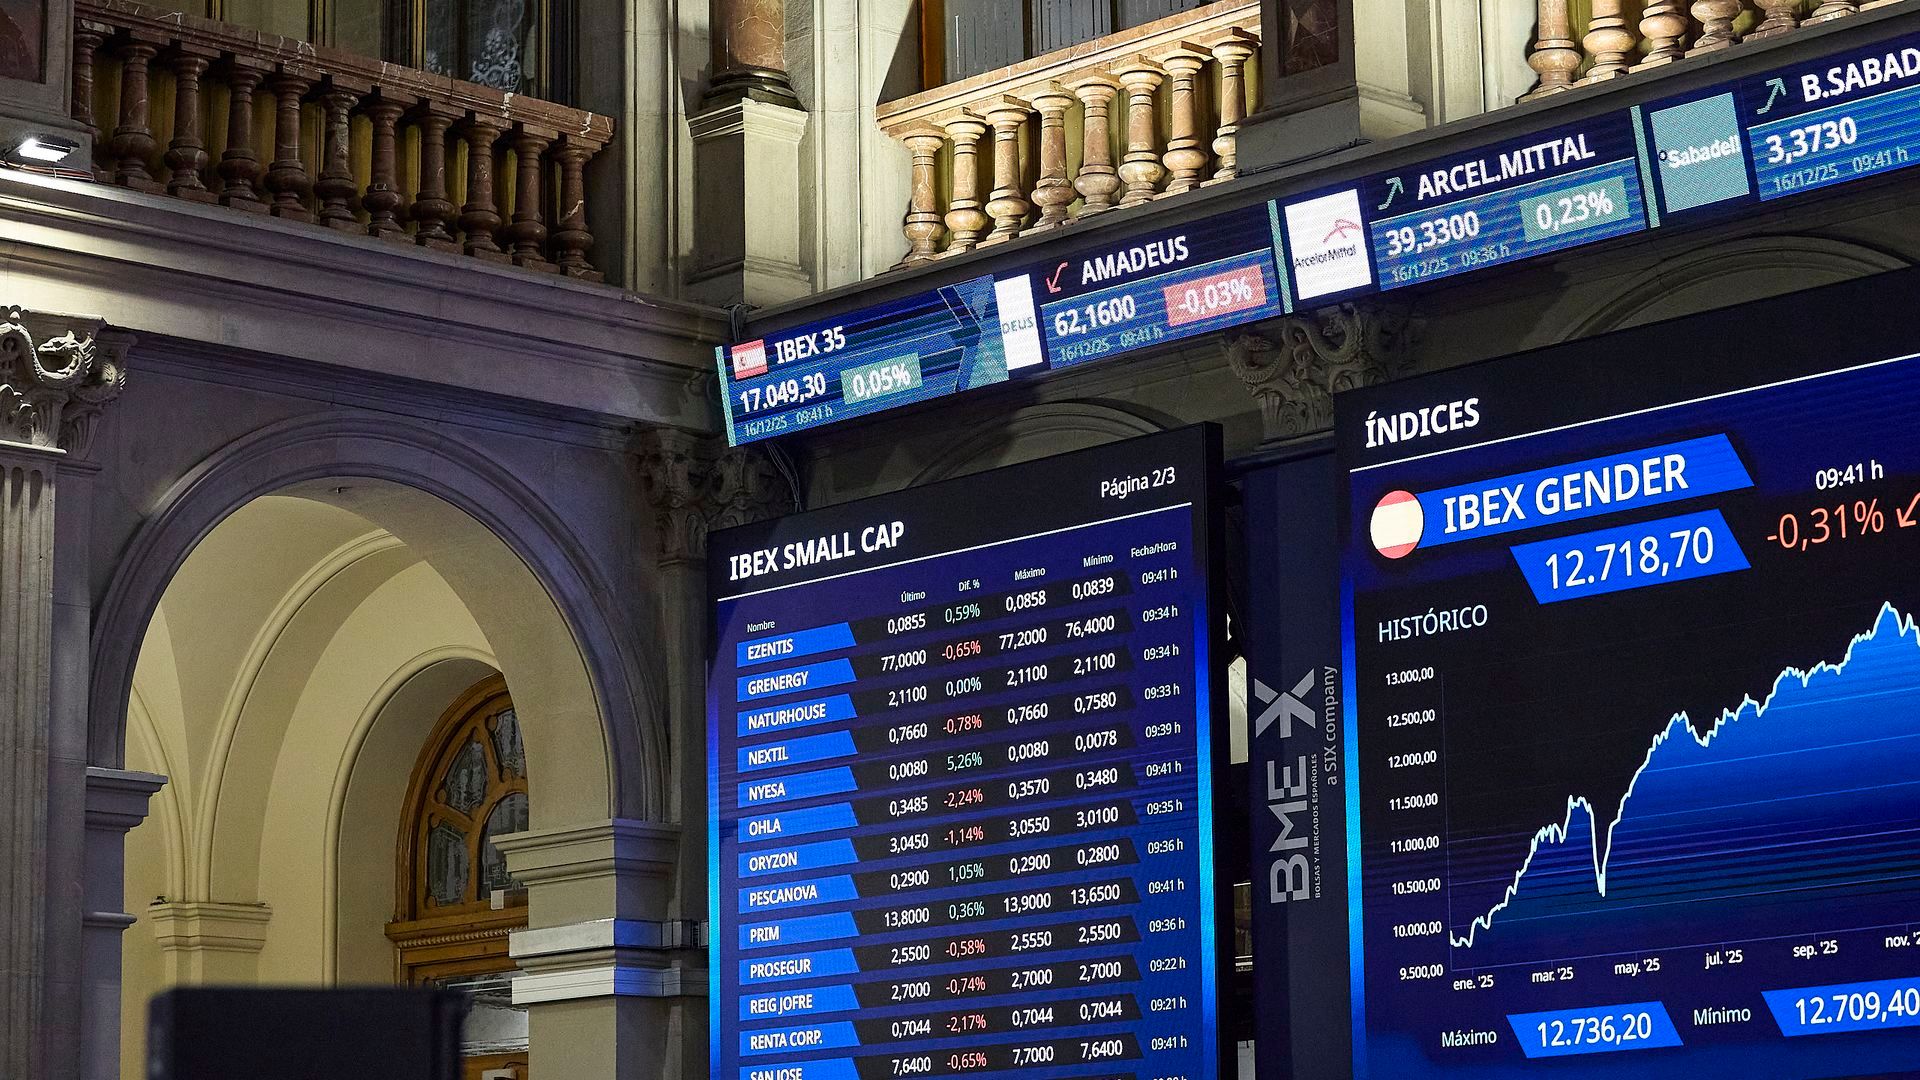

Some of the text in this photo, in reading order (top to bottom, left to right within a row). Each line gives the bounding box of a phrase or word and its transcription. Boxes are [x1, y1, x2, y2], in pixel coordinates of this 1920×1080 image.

[1801, 48, 1920, 102] B.SABAD
[1417, 134, 1596, 201] ARCEL.MITTAL
[1667, 135, 1742, 169] Sabadell
[1765, 117, 1857, 164] 3,3730
[1773, 151, 1892, 192] 16/12/25 09:41
[1385, 189, 1613, 257] 39,3300 0,23%
[1082, 236, 1189, 286] AMADEUS
[1294, 244, 1356, 269] ArcelorMittal
[1054, 276, 1252, 336] 62,1600 -0,03%
[775, 325, 846, 364] IBEX 35
[740, 363, 911, 412] 17.049,30 0,05%
[1365, 398, 1480, 449] ÍNDICES
[1102, 467, 1175, 499] Página 2/3
[1444, 454, 1688, 533] IBEX GENDER
[1816, 460, 1883, 490] 09:41 h
[730, 521, 904, 580] IBEX SMALL CAP
[1546, 499, 1884, 589] 12.718,70 -0,31%
[747, 542, 1176, 632] Nombre Último Dif. % Máximo Mínimo Fecha/Hora
[748, 569, 1166, 659] EZENTIS 0,0855 0,59% 0,0858 0,0839 09:41
[1379, 605, 1487, 642] HISTÓRICO
[748, 607, 1169, 695] GRENERGY 77,0000 -0,65% 77,2000 76,4000 09:34
[1386, 667, 1433, 685] 13.000,00
[749, 646, 1170, 729] NATURHOUSE 2,1100 0,00% 2,1100 2,1100 09:34
[749, 685, 1171, 765] NEXTIL 0,7660 -0,78% 0,7660 0,7580 09:33
[1324, 665, 1337, 785] a SIX company
[1387, 709, 1435, 727] 12.500,00
[749, 723, 1171, 800] NYESA 0,0080 5,26% 0,0080 0,0078 09:39
[1388, 751, 1436, 768] 12.000,00
[749, 762, 1171, 835] OHLA 0,3485 -2,24% 0,3570 0,3480 09:41
[1390, 793, 1438, 810] 11.500,00
[749, 800, 1173, 871] ORYZON 3,0450 -1,14% 3,0550 3,0100 09:35
[1267, 756, 1310, 904] BME
[1391, 836, 1439, 852] 11.000,00
[750, 840, 1174, 906] PESCANOVA 0,2900 1,05% 0,2900 0,2800 09:36
[1392, 878, 1440, 894] 10.500,00
[751, 880, 1173, 942] PRIM 13,8000 0,36% 13,9000 13,6500 09:41
[1393, 921, 1442, 937] 10.000,00
[751, 918, 1176, 978] PROSEGUR 2,5500 -0,58% 2,5550 2,5500 09:36
[1400, 964, 1443, 980] 9.500,00
[1453, 936, 1910, 991] ene. '25 mar. '25 may. '25 jul. '25 sep. '25 nov.
[751, 958, 1177, 1014] REIG JOFRE 2,7000 -0,74% 2,7000 2,7000 09:22
[751, 998, 1175, 1049] RENTA CORP. 0,7044 -2,17% 0,7044 0,7044 09:21
[1442, 988, 1920, 1047] Máximo 12.736,20 Mínimo 12.709,40
[892, 1057, 931, 1076] 7,6400
[947, 1053, 986, 1070] -0,65%
[1013, 1046, 1054, 1065] 7,7000
[1081, 1040, 1122, 1060] 7,6400
[1152, 1037, 1176, 1050] 09:41
